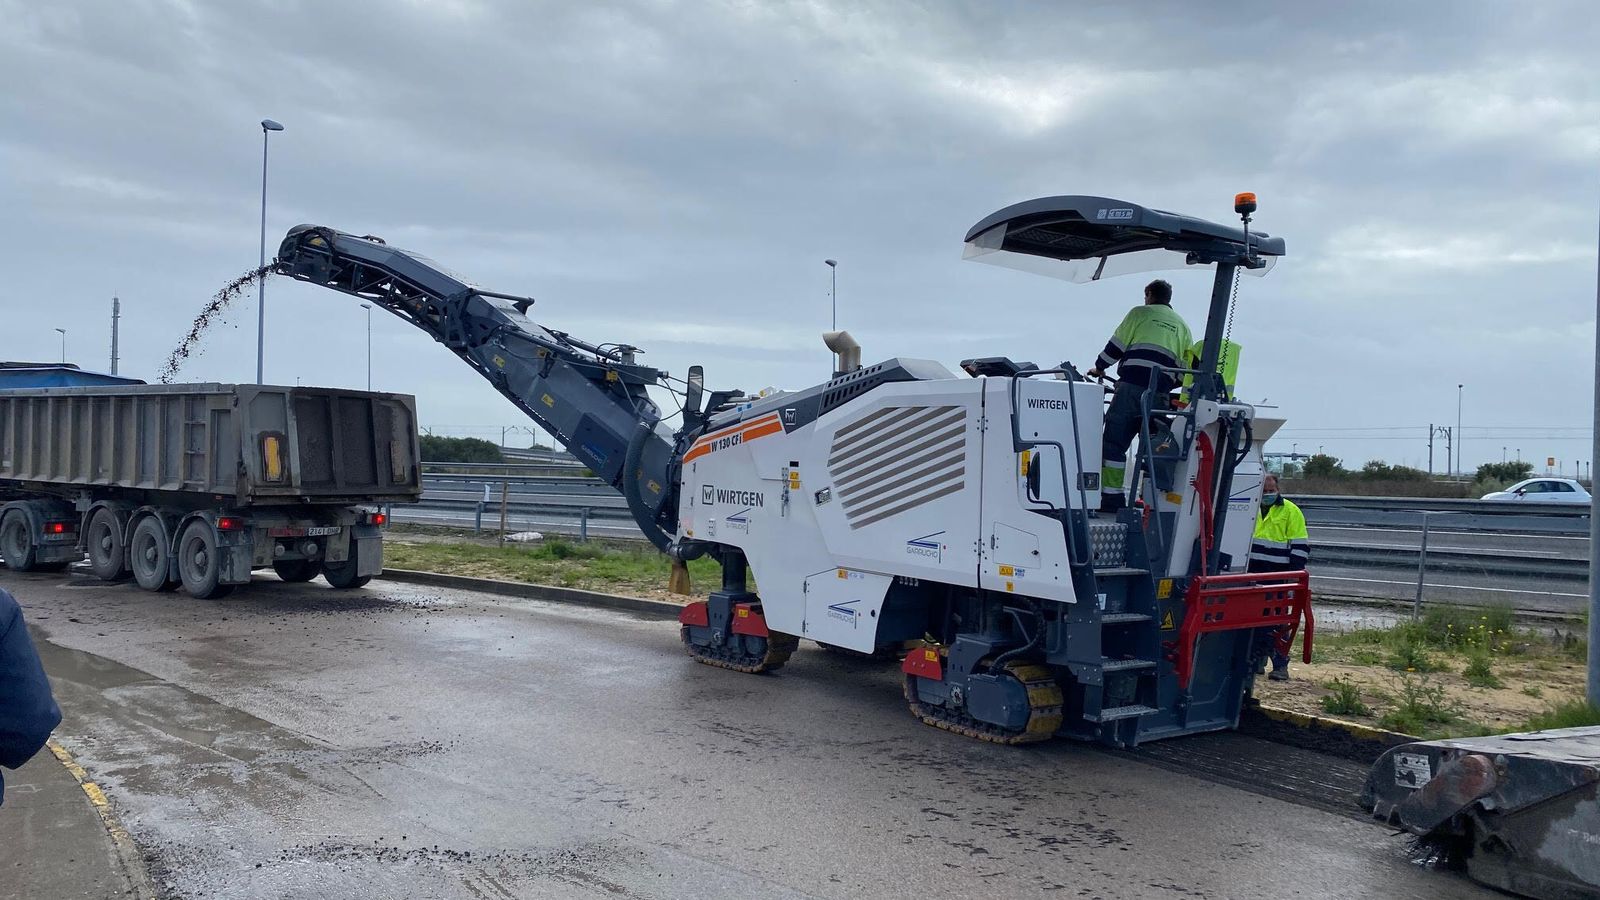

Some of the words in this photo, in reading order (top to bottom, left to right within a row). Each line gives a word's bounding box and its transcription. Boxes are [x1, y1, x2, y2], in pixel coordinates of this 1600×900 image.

[1027, 398, 1068, 410] WIRTGEN
[711, 441, 718, 452] W
[719, 437, 731, 450] 130
[717, 488, 764, 507] WIRTGEN
